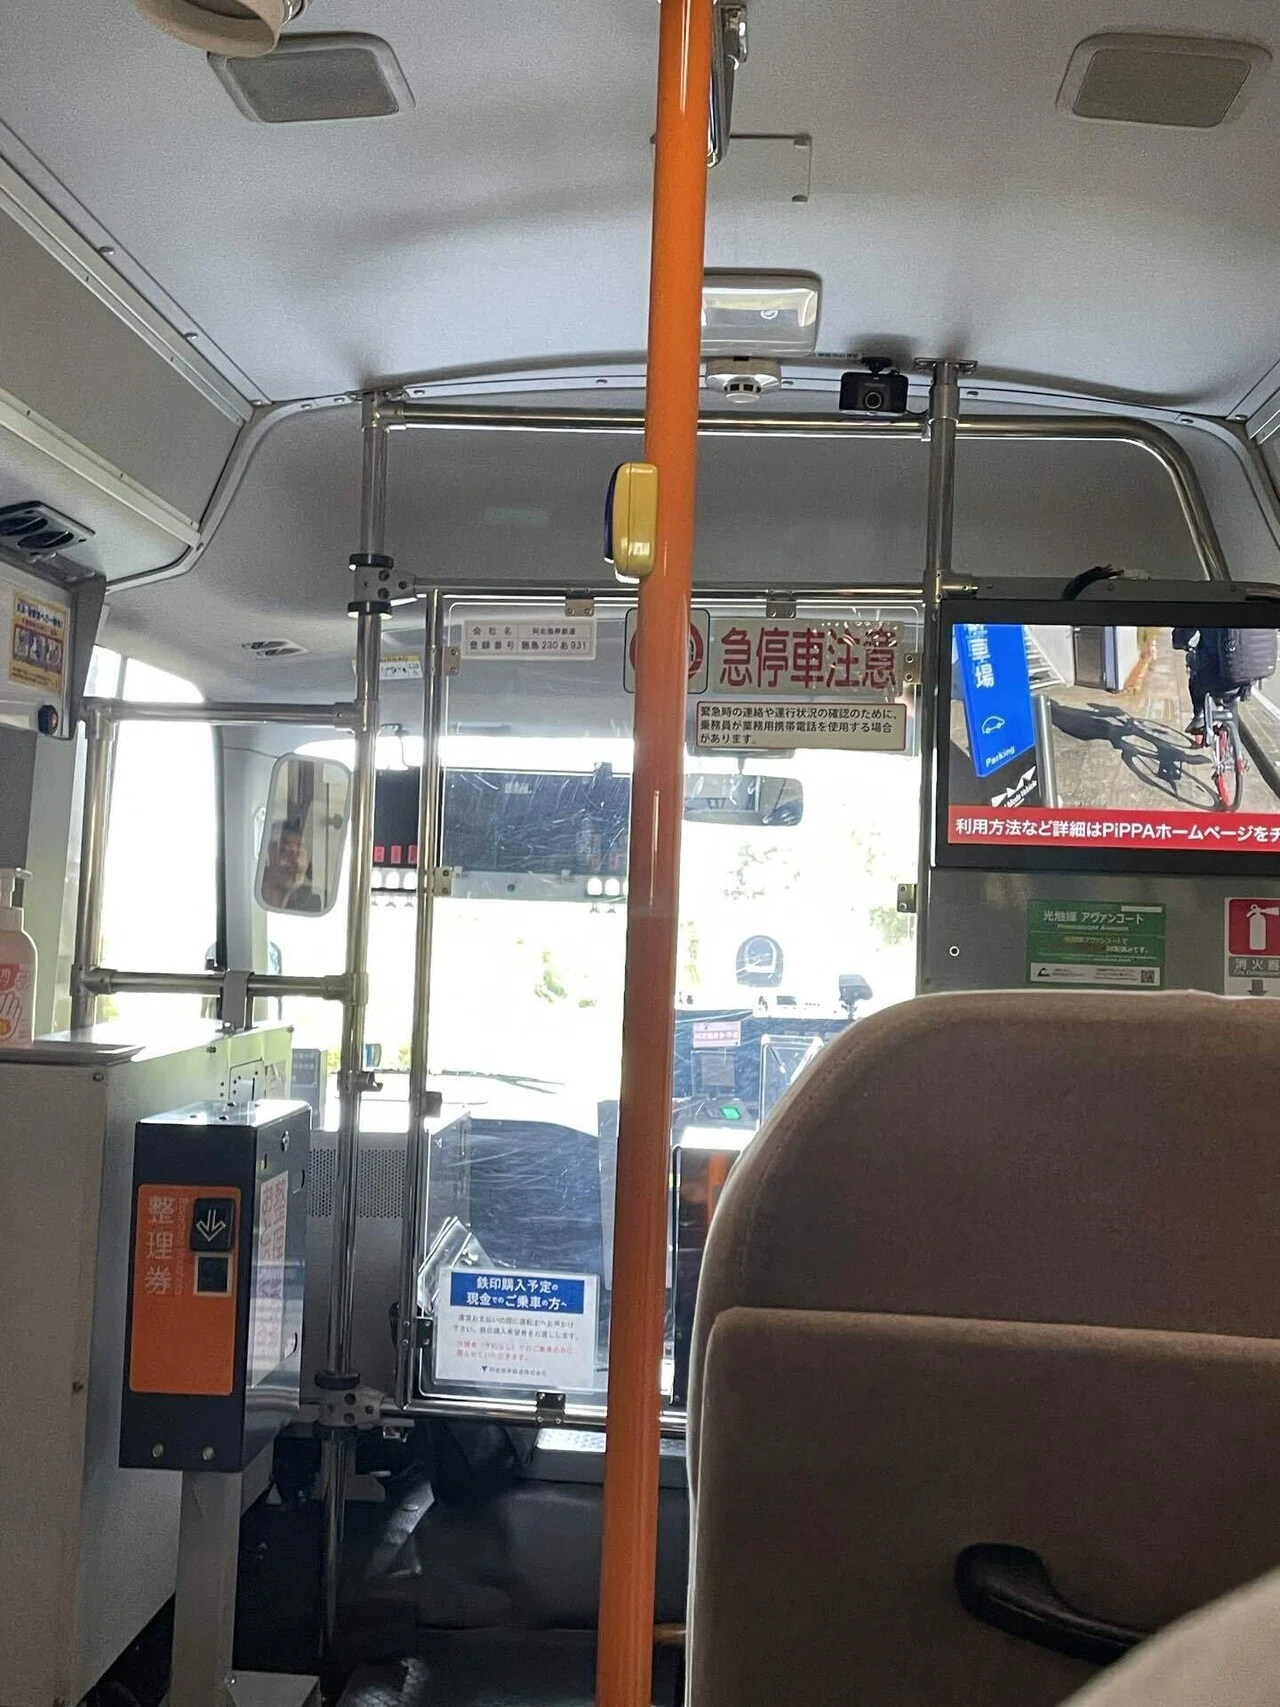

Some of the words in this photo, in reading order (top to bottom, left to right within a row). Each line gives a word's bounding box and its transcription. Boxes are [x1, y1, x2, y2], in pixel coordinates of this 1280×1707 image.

[472, 626, 512, 636] 会社名
[469, 641, 515, 650] 登録番号
[719, 626, 897, 690] 急停車注意
[700, 706, 898, 720] 緊急時の連絡や運行状況の確認のために、
[700, 719, 892, 733] 乗務員が業務用携帯電話を使用する場合
[700, 732, 757, 745] があります。
[985, 746, 1016, 767] Parking
[1081, 912, 1145, 925] アヴァンコート
[144, 1195, 175, 1296] 整理券
[476, 1275, 559, 1294] 鉄印購入予定の
[466, 1291, 569, 1312] 現金でのご乗車の方へ
